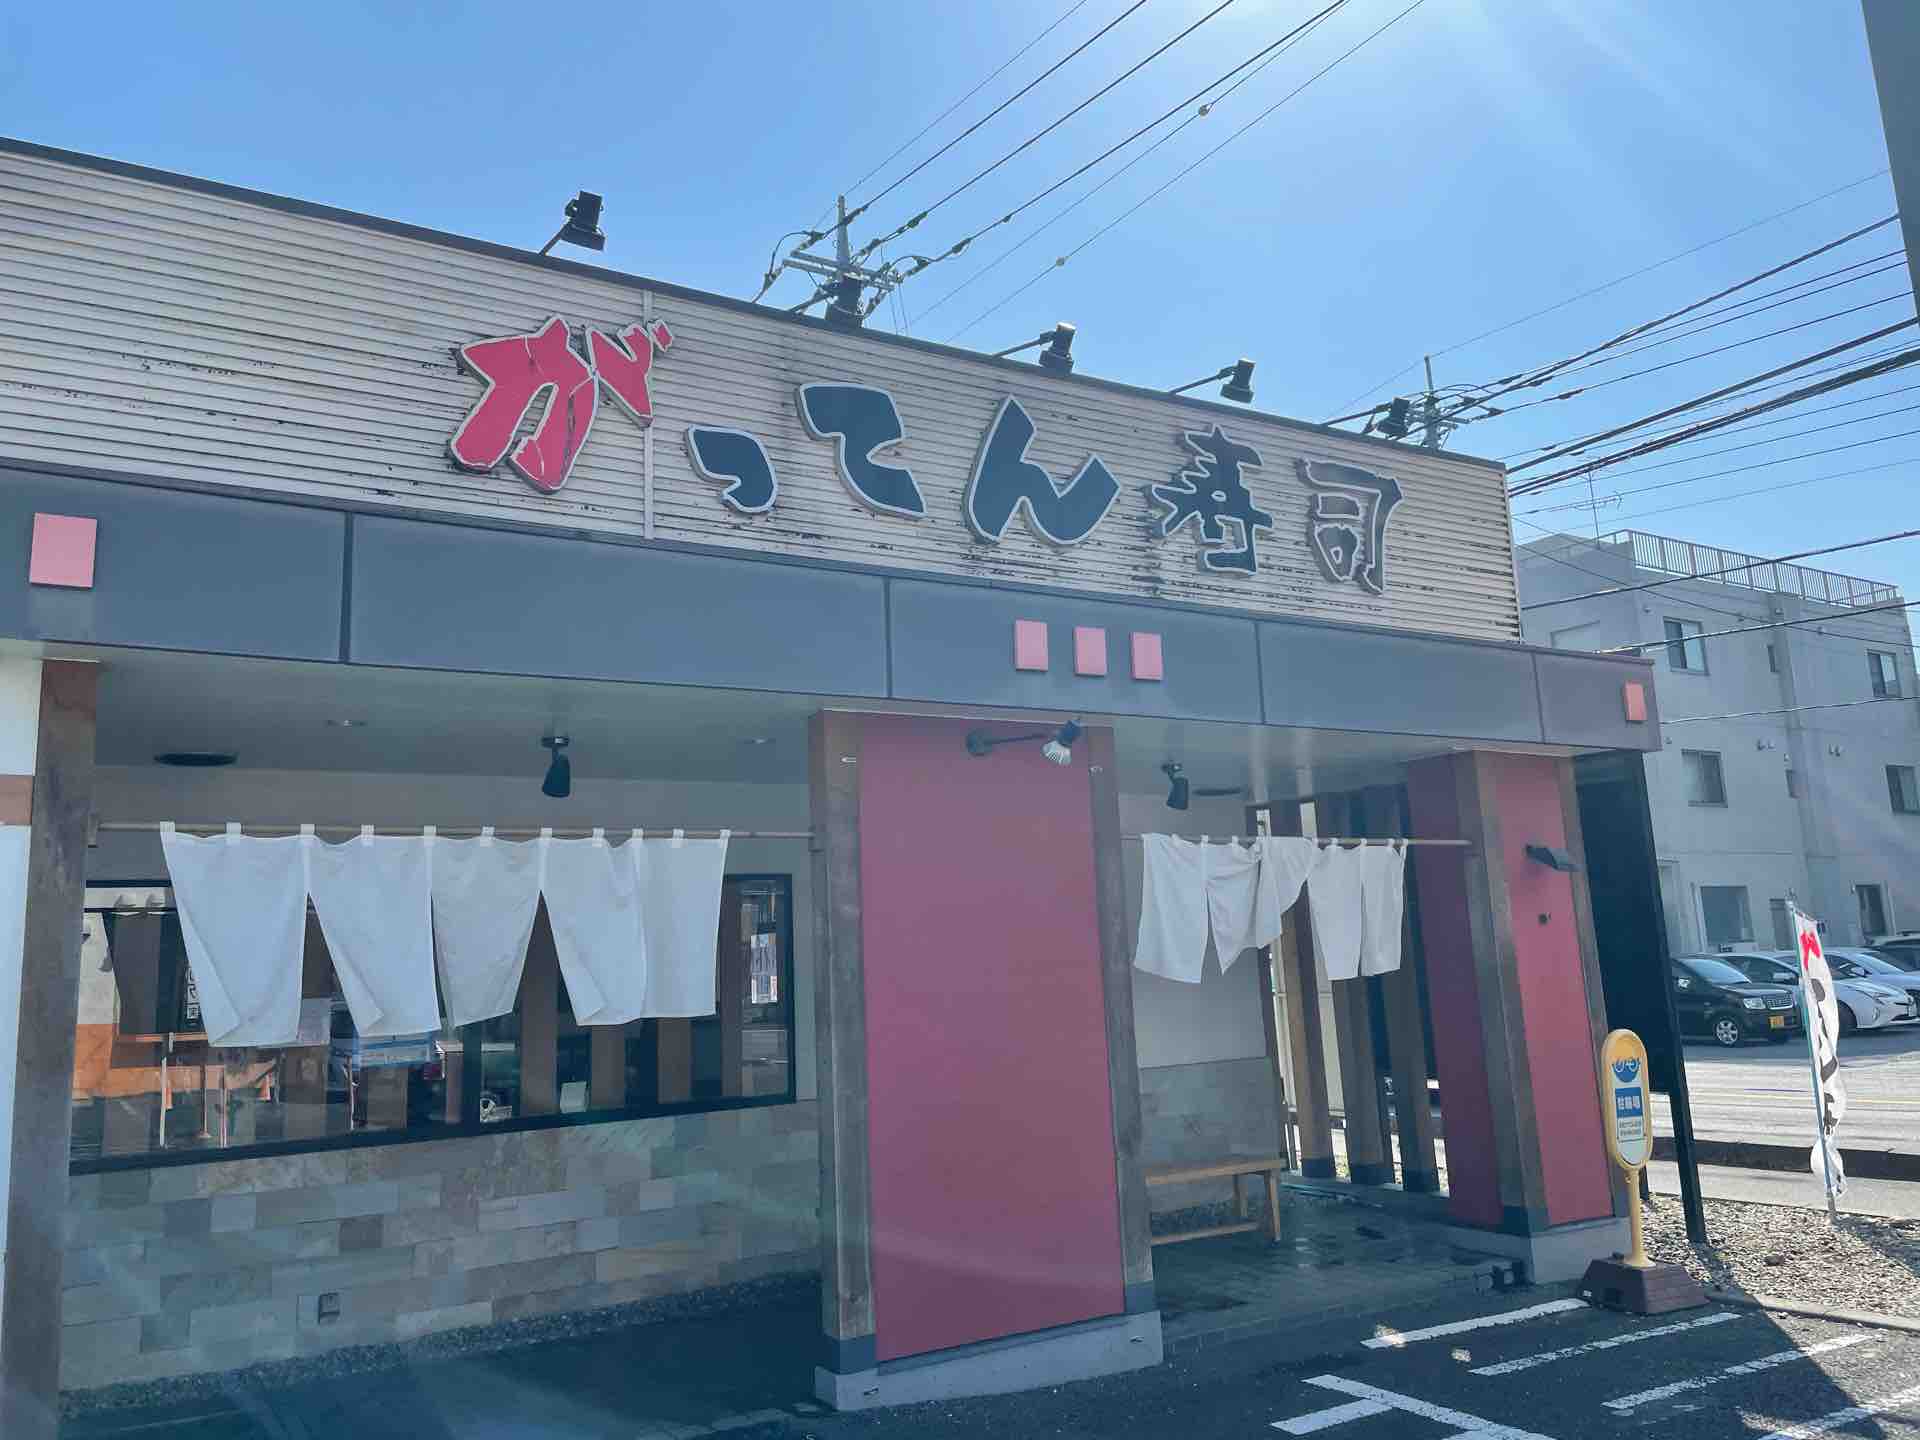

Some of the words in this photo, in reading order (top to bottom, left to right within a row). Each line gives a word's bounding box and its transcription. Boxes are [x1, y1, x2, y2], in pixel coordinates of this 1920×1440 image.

[449, 315, 1403, 595] がってん寿司
